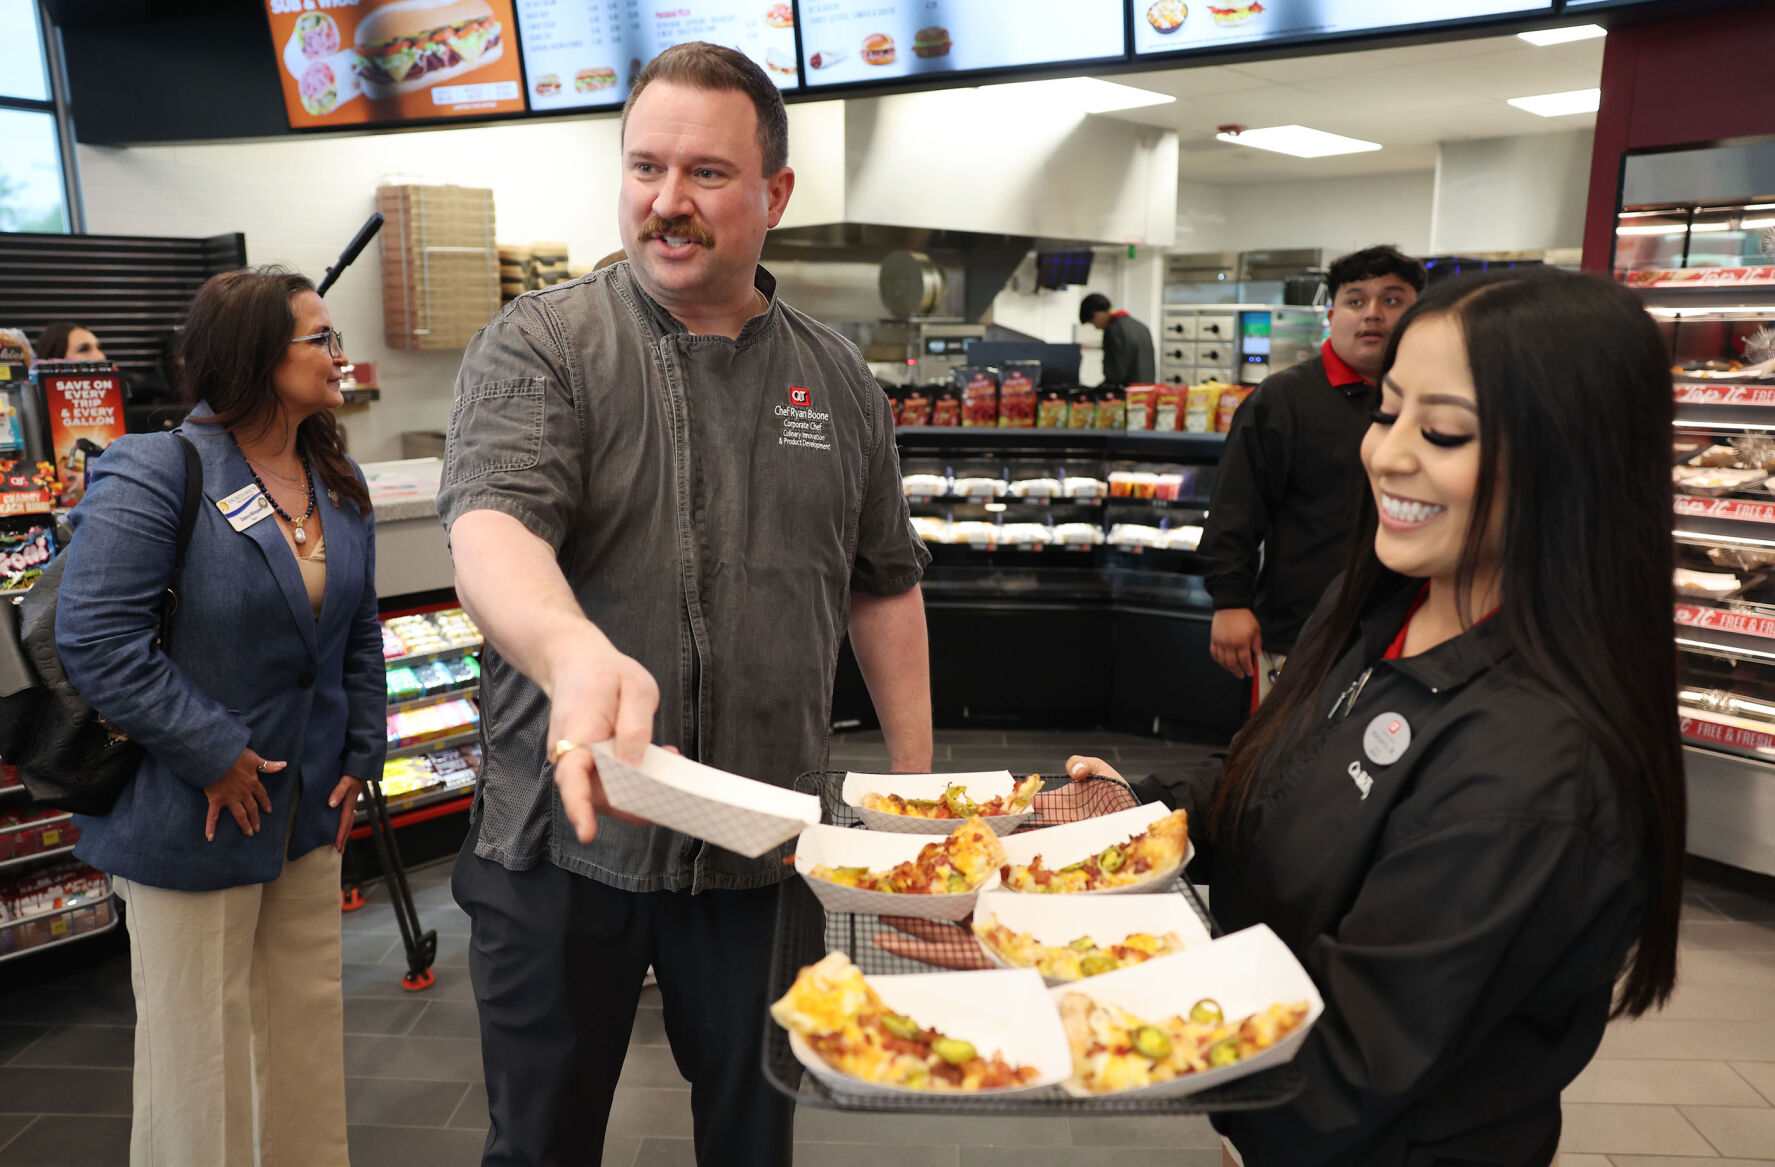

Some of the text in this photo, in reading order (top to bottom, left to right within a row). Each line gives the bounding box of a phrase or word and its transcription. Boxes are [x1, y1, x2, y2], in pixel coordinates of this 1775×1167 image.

[56, 379, 113, 391] SAVE ON
[64, 389, 106, 400] EVERY
[792, 390, 807, 402] QT
[1752, 389, 1775, 402] FRE
[72, 399, 102, 408] TRIP
[61, 407, 114, 418] & EVERY
[774, 405, 829, 421] Chef Ryan Boone
[63, 416, 115, 427] GALLON
[783, 419, 822, 431] Corporate Chef
[783, 429, 825, 441] Culinary Innovation
[779, 437, 831, 451] & Product Development
[1735, 503, 1763, 518] FREE
[1720, 613, 1747, 630] FREE
[1747, 618, 1758, 632] &
[1697, 722, 1722, 739] FREE
[1724, 727, 1734, 742] &
[1736, 729, 1773, 748] FRESH
